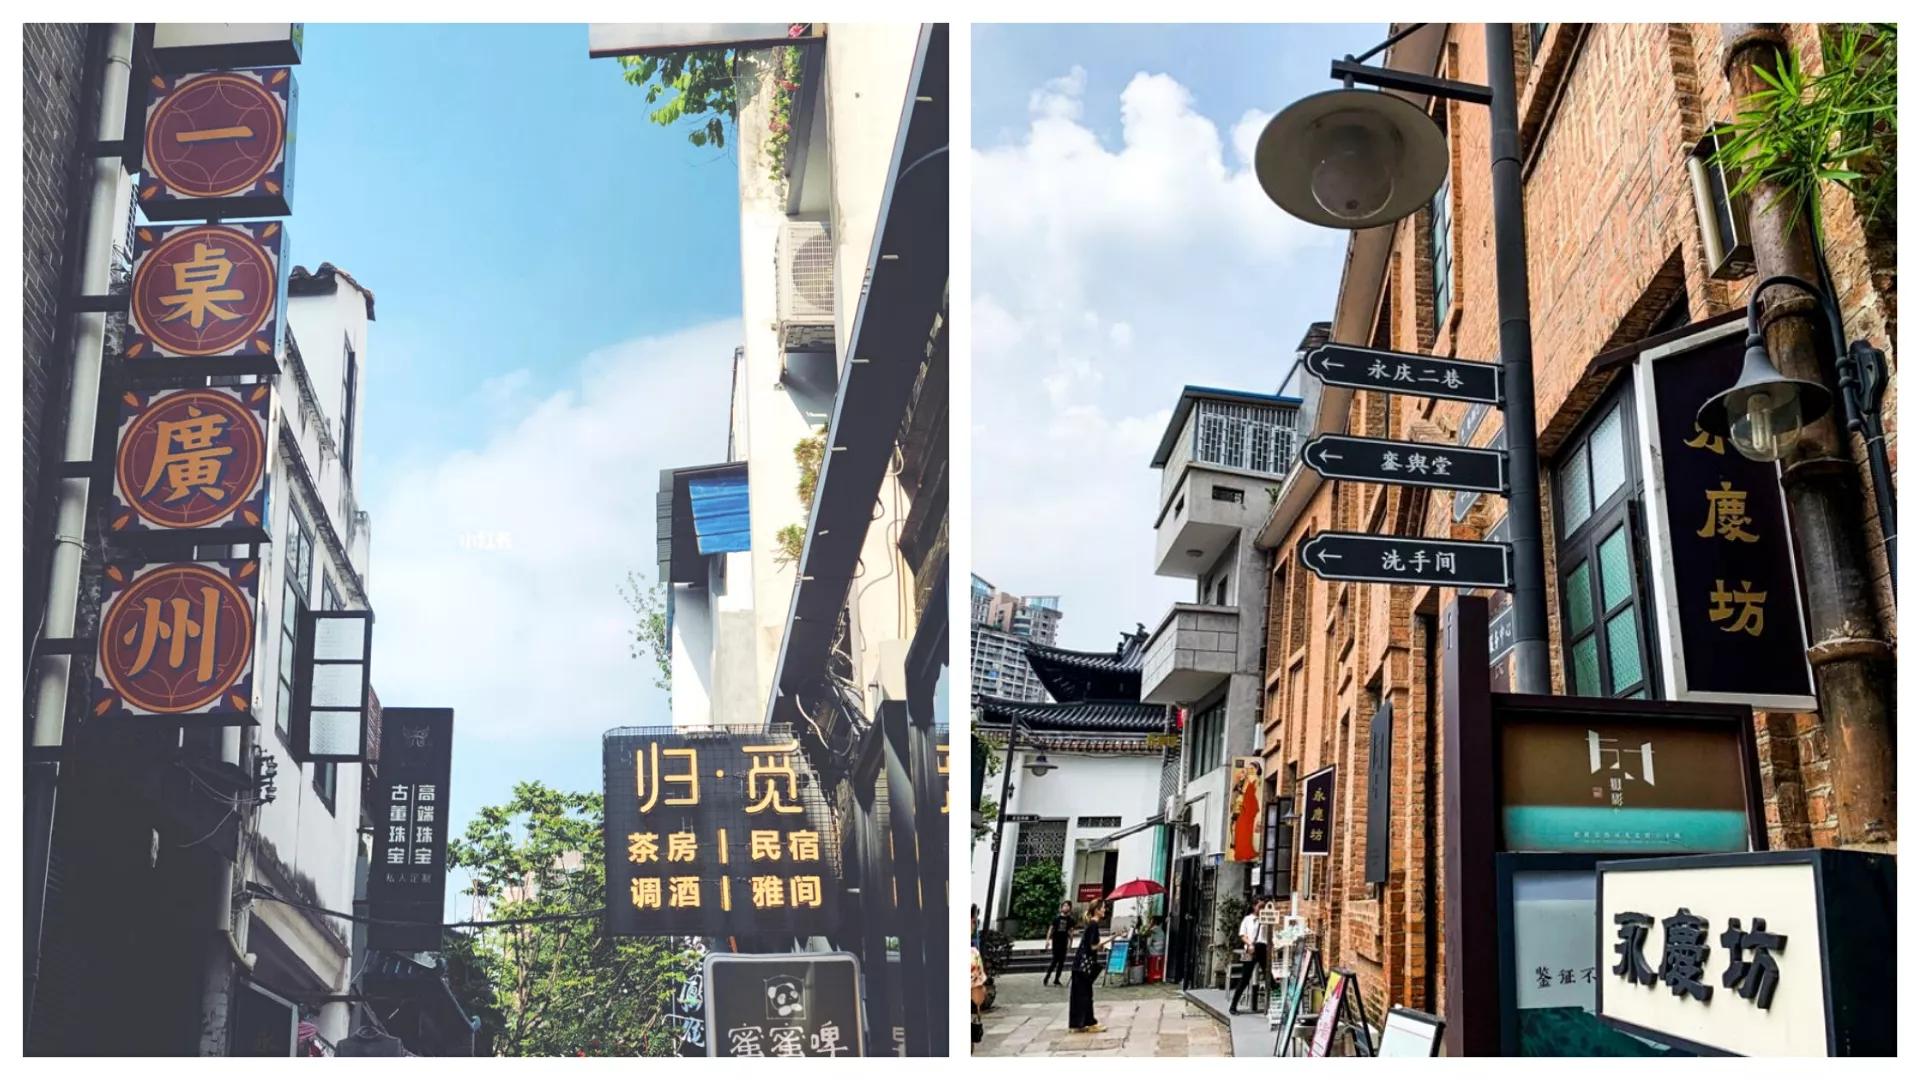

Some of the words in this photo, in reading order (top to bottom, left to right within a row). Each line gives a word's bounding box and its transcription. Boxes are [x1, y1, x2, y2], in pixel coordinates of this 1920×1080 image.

[1367, 358, 1464, 390] 永庆二巷
[122, 124, 254, 683] 一桌廣州
[1381, 549, 1457, 575] 洗手间
[387, 783, 409, 865] 古董珠宝
[414, 784, 436, 865] 高端珠宝
[627, 830, 699, 864] 茶房
[750, 829, 820, 862] 民宿
[629, 876, 701, 909] 调酒
[751, 875, 823, 908] 雅间
[1611, 906, 1789, 1013] 永慶坊
